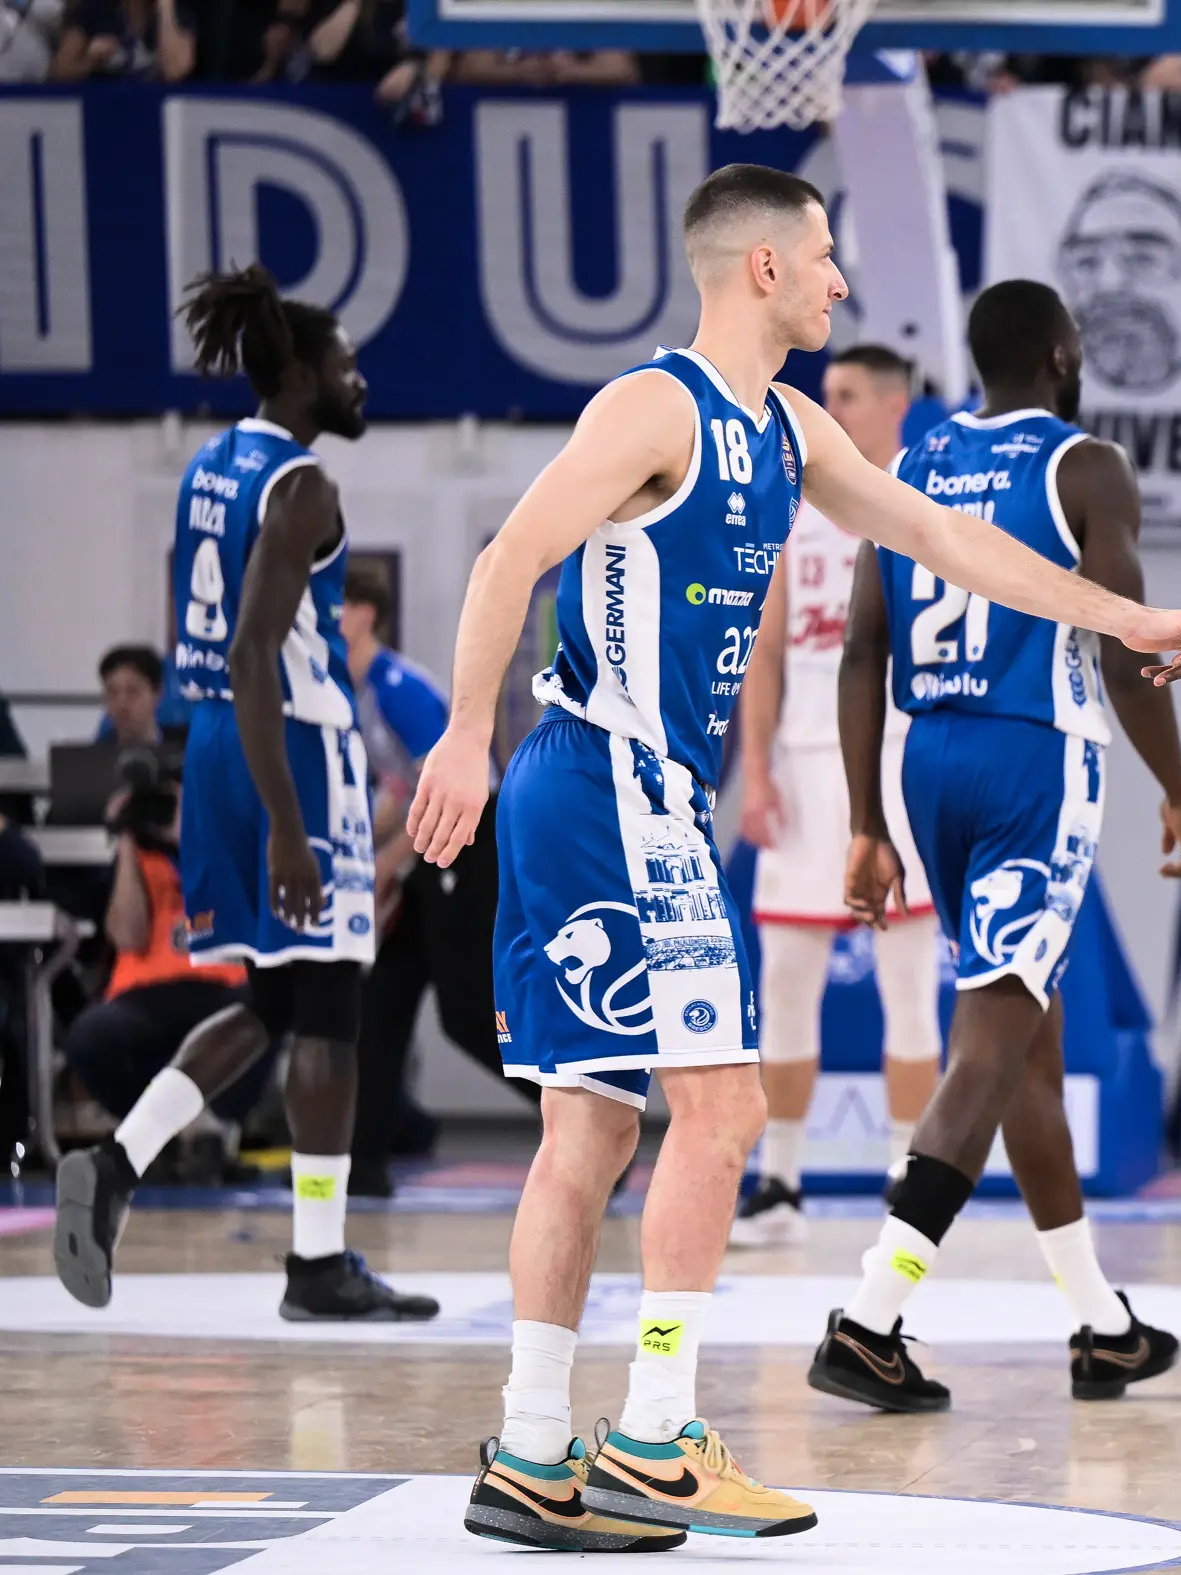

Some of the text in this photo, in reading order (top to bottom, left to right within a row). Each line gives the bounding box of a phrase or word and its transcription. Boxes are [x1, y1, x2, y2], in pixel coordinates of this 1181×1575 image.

[711, 418, 752, 484] 18
[733, 543, 779, 575] TECH
[605, 544, 627, 666] GERMANI
[716, 625, 759, 676] a2
[711, 681, 731, 696] LIFE
[643, 1339, 672, 1352] PRS
